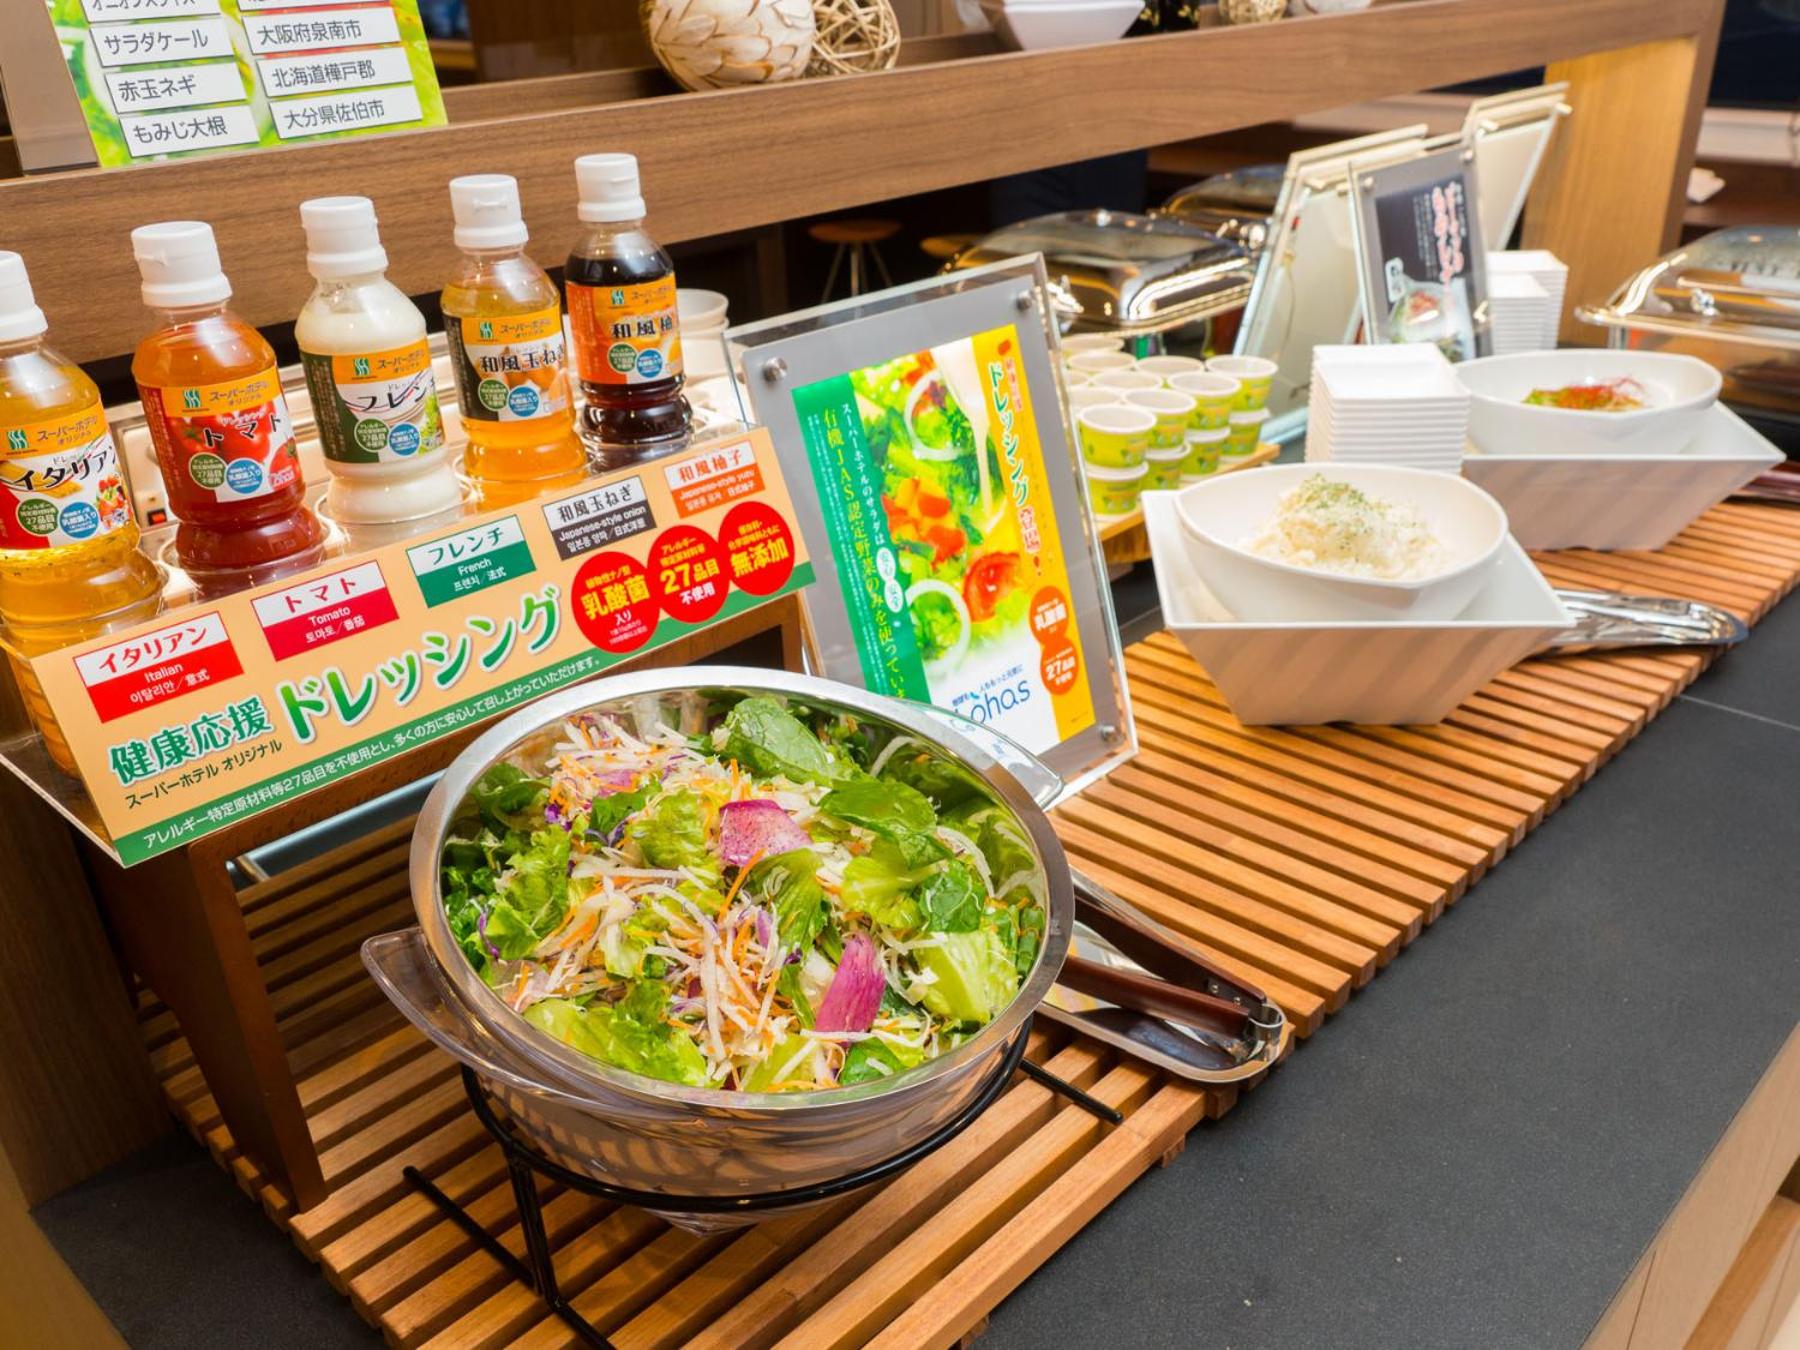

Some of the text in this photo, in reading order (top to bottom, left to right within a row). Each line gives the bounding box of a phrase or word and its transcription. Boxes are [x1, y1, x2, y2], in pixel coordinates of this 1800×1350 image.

[104, 28, 209, 54] サラダケール
[257, 19, 362, 45] 大阪府泉南市
[118, 74, 197, 102] 赤玉ネギ
[272, 60, 376, 88] 北海道樺戸郡
[133, 115, 228, 144] もみじ大根
[284, 101, 386, 130] 大分県佐伯市
[202, 412, 281, 448] トマト
[557, 483, 633, 523] 和風玉ねぎ
[559, 505, 648, 543] Japanese-style onion
[427, 527, 504, 566] フレンチ
[730, 536, 790, 579] 無添加
[457, 557, 493, 577] French
[659, 557, 721, 596] 27品目
[284, 577, 357, 614] トマト
[580, 573, 651, 621] 乳酸菌
[679, 580, 717, 606] 不使用
[308, 606, 352, 627] Tomato
[614, 608, 633, 627] 入り
[98, 626, 208, 674] イタリアン
[276, 583, 561, 744] ドレッシング
[144, 661, 184, 684] Italian
[108, 695, 274, 786] 健康応援
[124, 738, 284, 810] スーパーホテル オリジナル
